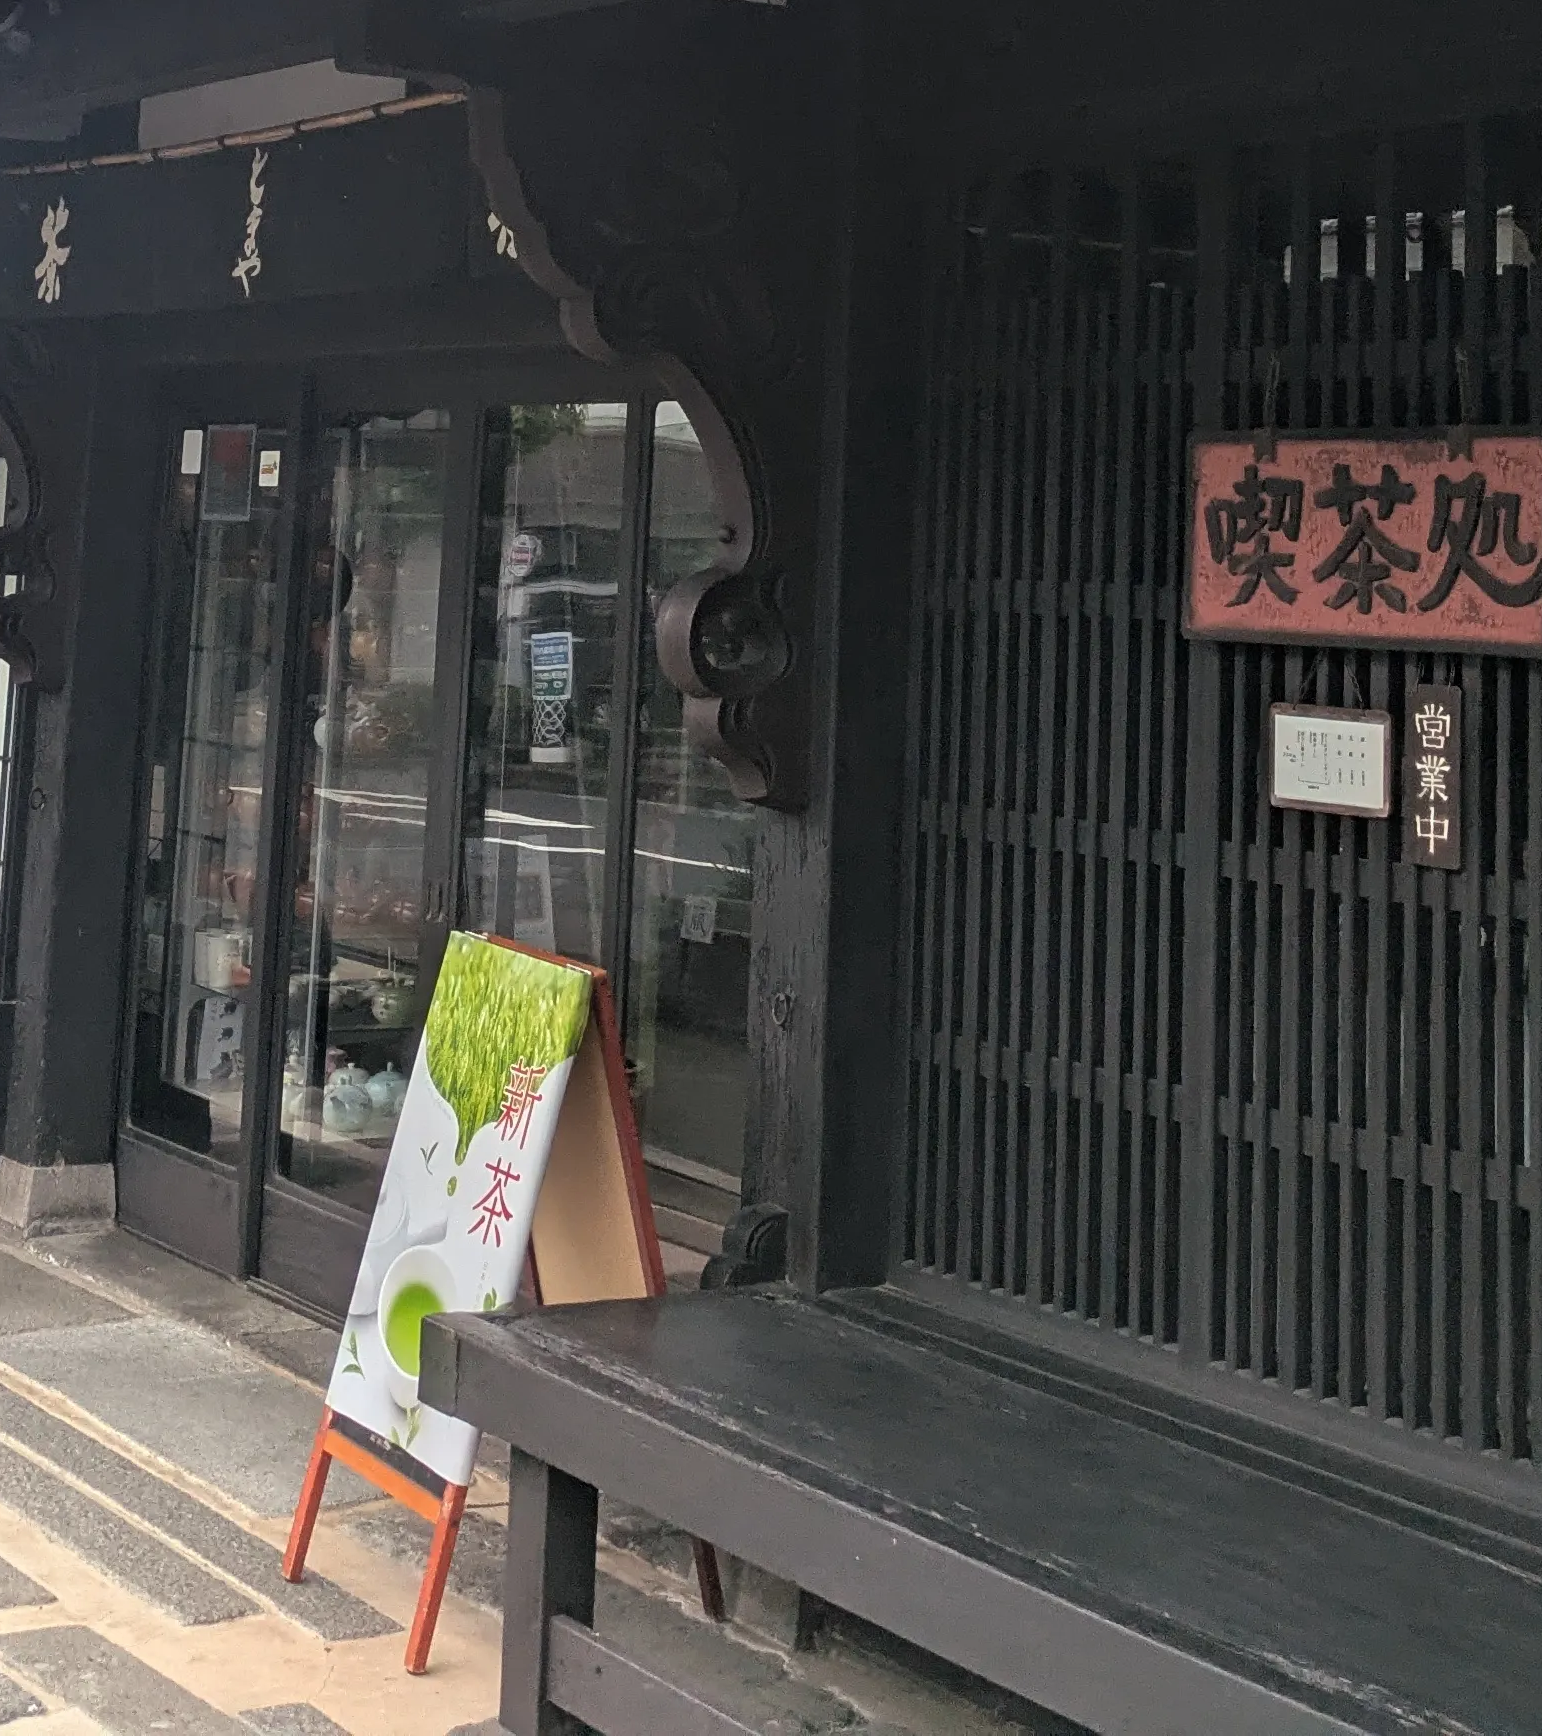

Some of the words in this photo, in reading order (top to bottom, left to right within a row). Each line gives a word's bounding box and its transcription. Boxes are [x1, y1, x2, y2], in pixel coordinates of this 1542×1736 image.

[1414, 703, 1452, 855] 営業中
[467, 1056, 546, 1249] 新茶
